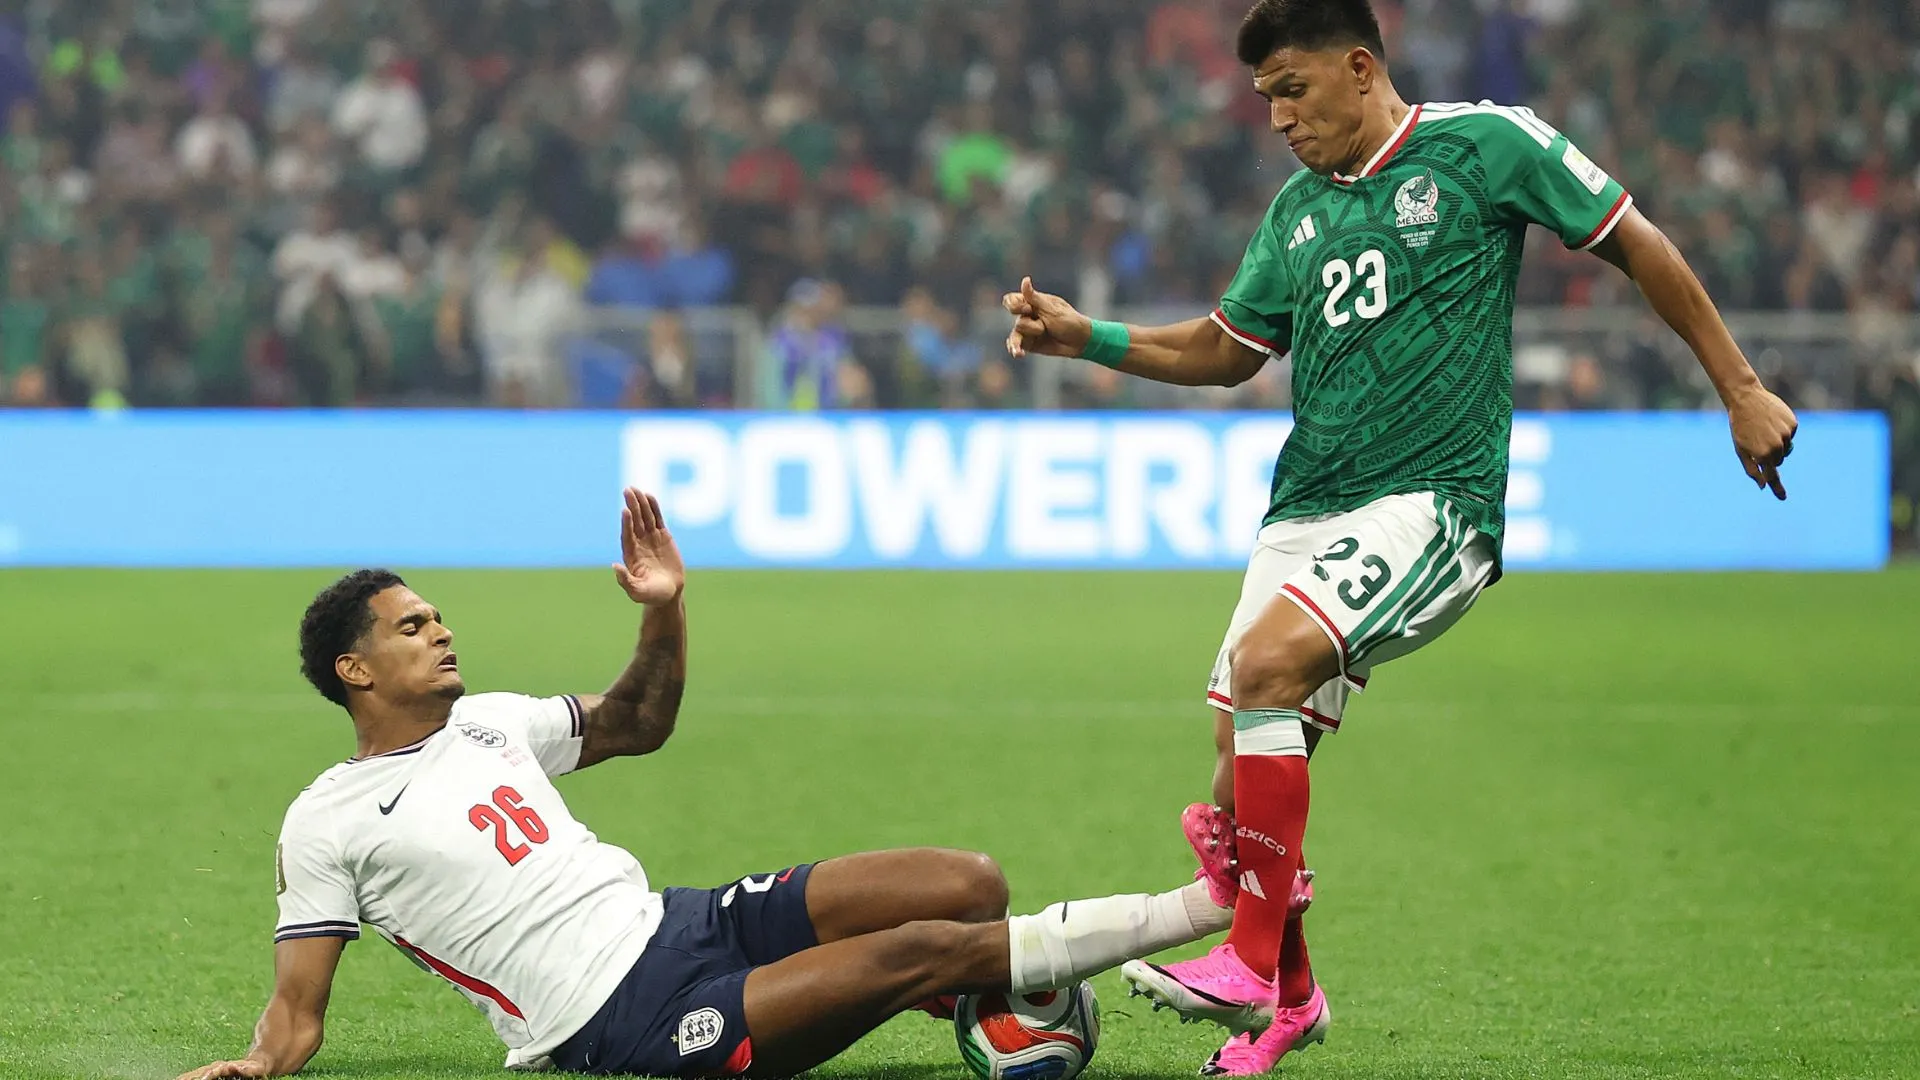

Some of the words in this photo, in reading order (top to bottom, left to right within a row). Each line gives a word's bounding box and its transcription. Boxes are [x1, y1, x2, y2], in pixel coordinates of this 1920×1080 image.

[1322, 249, 1387, 327] 23
[622, 419, 1552, 560] POWERE
[1311, 537, 1391, 610] 23
[468, 784, 549, 867] 26
